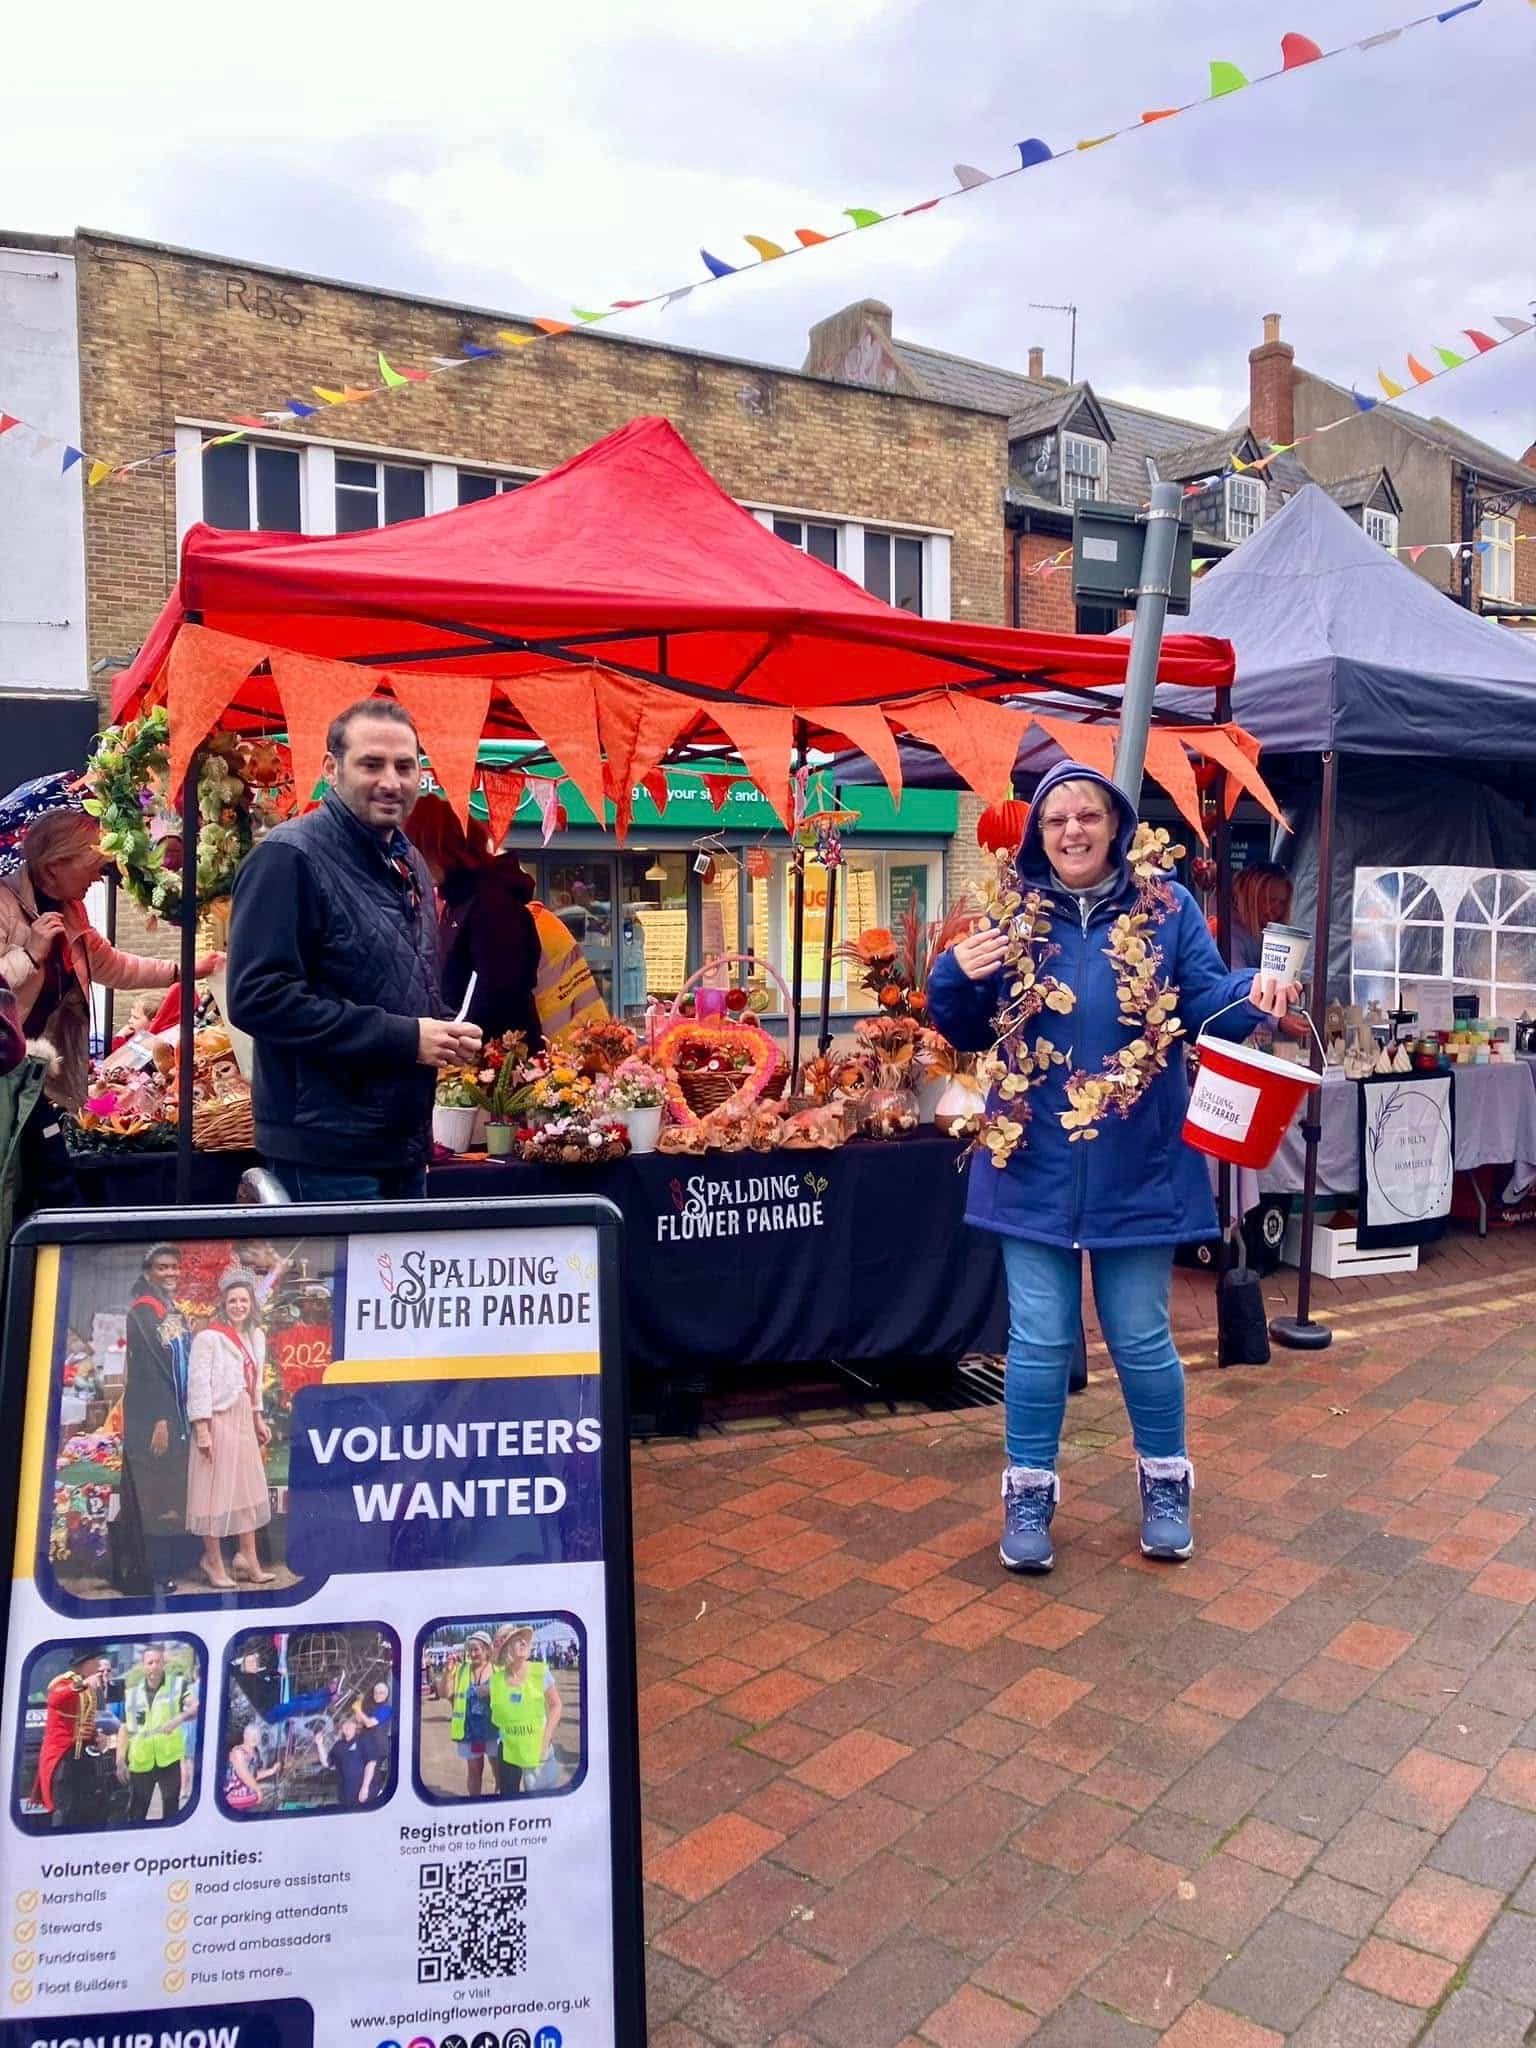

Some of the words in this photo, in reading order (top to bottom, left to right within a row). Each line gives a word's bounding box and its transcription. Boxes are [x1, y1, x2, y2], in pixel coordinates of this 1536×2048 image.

[226, 277, 303, 327] RBS
[667, 788, 697, 801] your
[700, 787, 733, 803] sit
[735, 789, 758, 802] and
[1211, 1105, 1240, 1124] PARADE
[681, 1174, 799, 1218] SPALDING
[657, 1209, 740, 1241] FLOWER
[747, 1201, 824, 1233] PARADE
[391, 1250, 559, 1305] SPALDING
[357, 1296, 471, 1330] FLOWER
[483, 1292, 591, 1326] PARADE
[307, 1417, 602, 1464] VOLUNTEERS
[352, 1476, 567, 1523] WANTED
[400, 1819, 505, 1843] Registration
[508, 1816, 552, 1832] Form
[400, 1845, 426, 1856] Scan
[429, 1843, 446, 1853] the
[448, 1842, 463, 1852] QR
[466, 1841, 476, 1851] to
[478, 1837, 499, 1850] find
[501, 1838, 518, 1848] out
[520, 1835, 548, 1846] more
[40, 1861, 130, 1879] Volunteer
[134, 1849, 263, 1876] Opportunities:
[194, 1880, 230, 1895] Road
[233, 1877, 281, 1892] closure
[284, 1870, 351, 1887] assistants
[42, 1889, 107, 1905] Marshalls
[193, 1915, 218, 1927] Car
[221, 1909, 272, 1928] parking
[275, 1902, 348, 1921] attendants
[40, 1920, 103, 1936] Stewards
[191, 1940, 236, 1955] Crowd
[239, 1932, 332, 1951] ambassadors
[38, 1950, 117, 1965] Fundraisers
[38, 1981, 70, 1994] Float
[74, 1979, 128, 1993] Builders
[191, 1972, 218, 1984] Plus
[221, 1968, 245, 1982] lots
[453, 1990, 466, 2001] Or
[468, 1987, 491, 2000] Visit
[350, 1996, 591, 2028] www.spaldingflowerparade.org.uk
[160, 2026, 240, 2048] NOW
